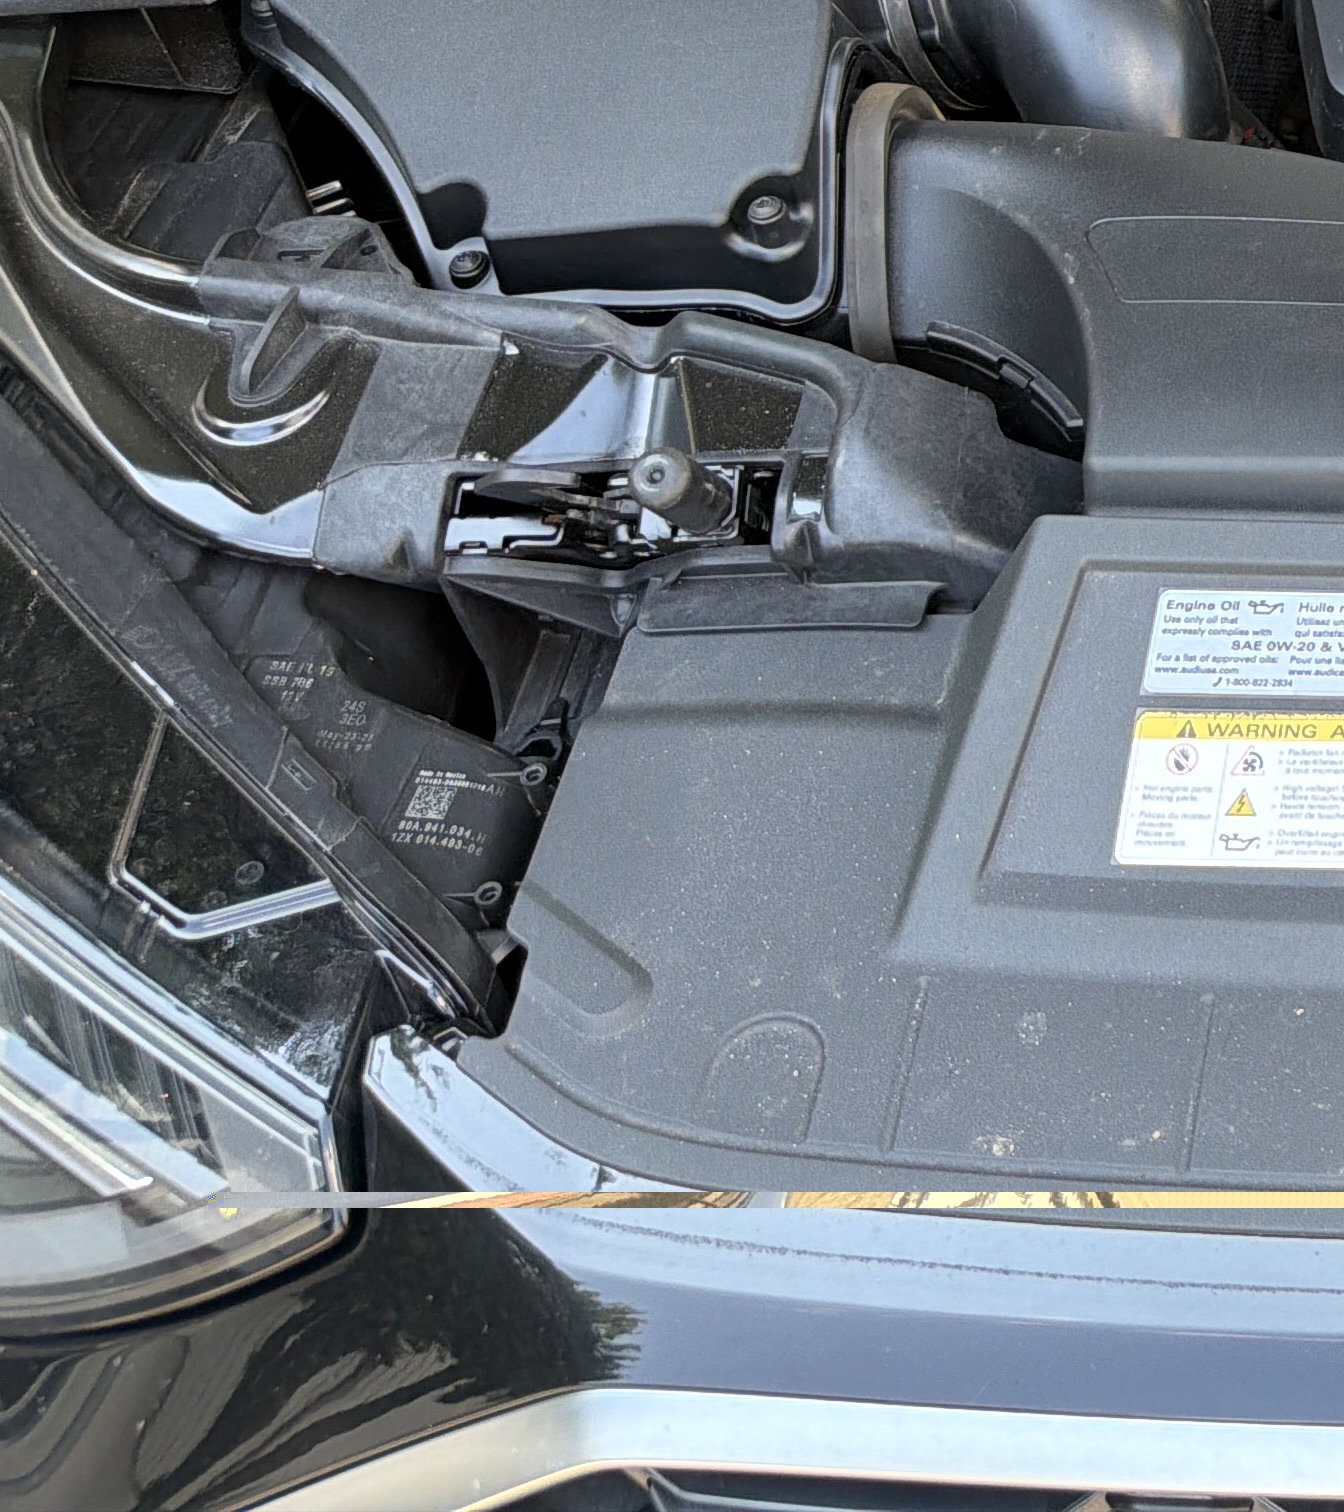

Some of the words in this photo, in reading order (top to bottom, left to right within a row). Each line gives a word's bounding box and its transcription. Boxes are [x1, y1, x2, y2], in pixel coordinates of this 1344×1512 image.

[1166, 599, 1216, 612] Engine
[1220, 600, 1240, 611] Oil
[1298, 602, 1335, 613] Huile
[1163, 615, 1181, 624] Use
[1184, 616, 1204, 626] only
[1206, 615, 1218, 624] oil
[1220, 616, 1239, 625] that
[1161, 627, 1206, 637] expressly
[1208, 628, 1249, 638] complies
[1252, 628, 1272, 636] with
[1294, 630, 1310, 639] qui
[1230, 640, 1263, 651] SAE
[1266, 641, 1316, 652] 0W-20
[1320, 642, 1332, 652] &
[1156, 653, 1173, 661] For
[1183, 653, 1197, 662] list
[1200, 654, 1210, 662] of
[1211, 655, 1256, 665] approved
[1289, 655, 1313, 664] Pour
[1314, 657, 1332, 665] une
[1154, 666, 1240, 674] www.audiusa.com
[1206, 723, 1318, 740] WARNING
